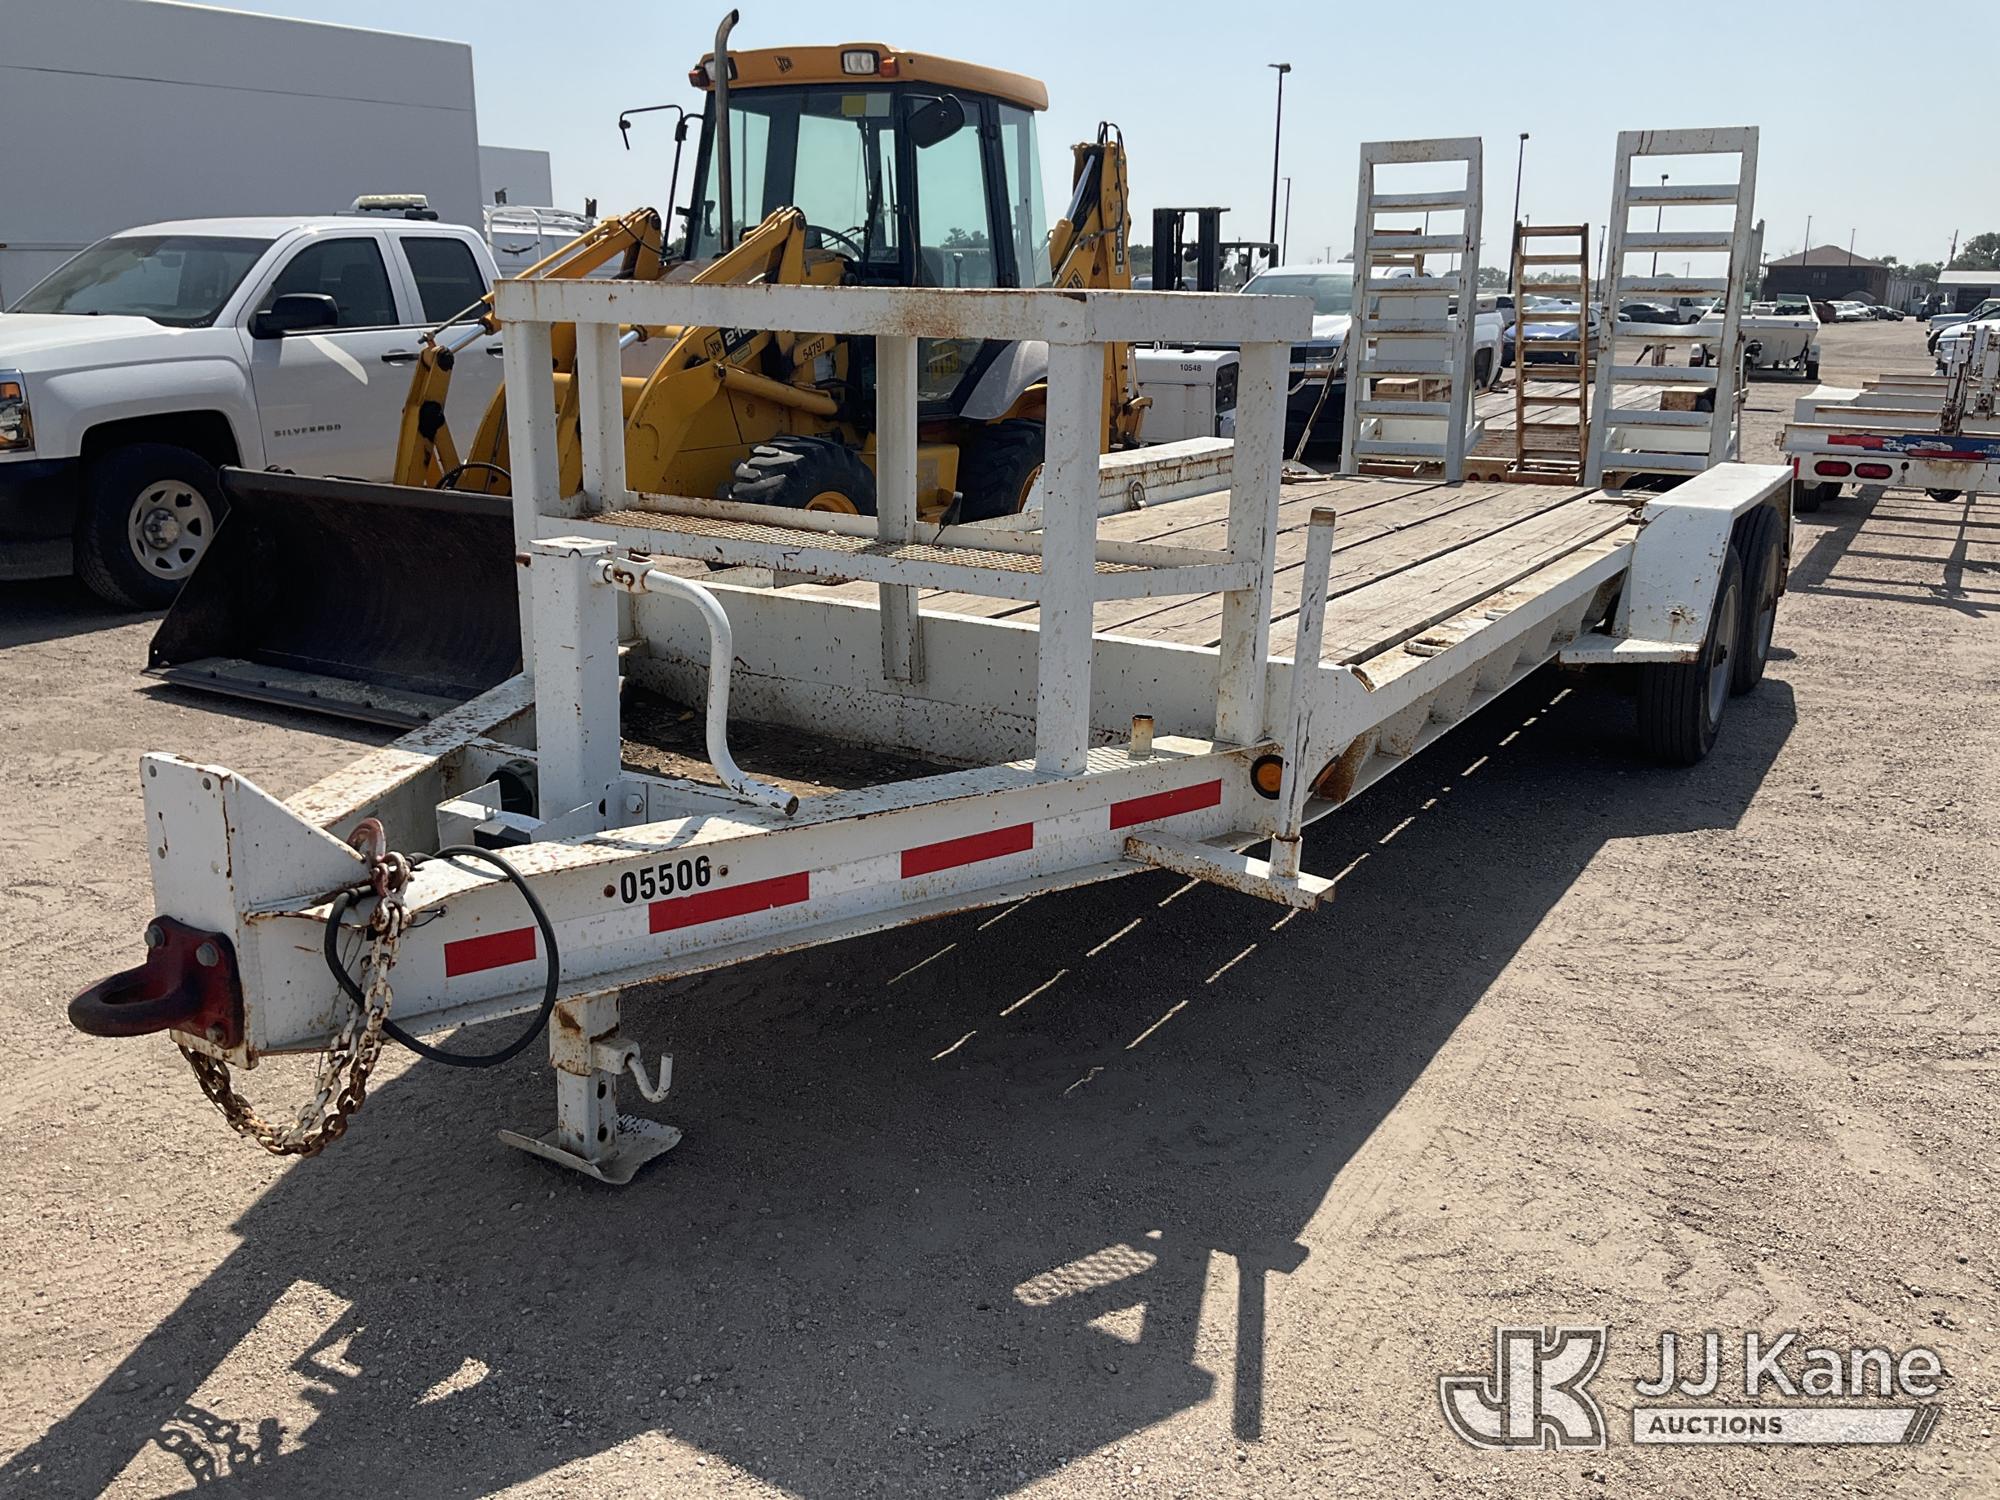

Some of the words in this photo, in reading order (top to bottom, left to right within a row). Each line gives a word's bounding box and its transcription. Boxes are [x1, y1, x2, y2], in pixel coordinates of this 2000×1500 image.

[802, 337, 826, 360] 54797
[1180, 363, 1202, 372] 10548
[274, 423, 342, 437] SILVERADO
[620, 855, 712, 904] 05506
